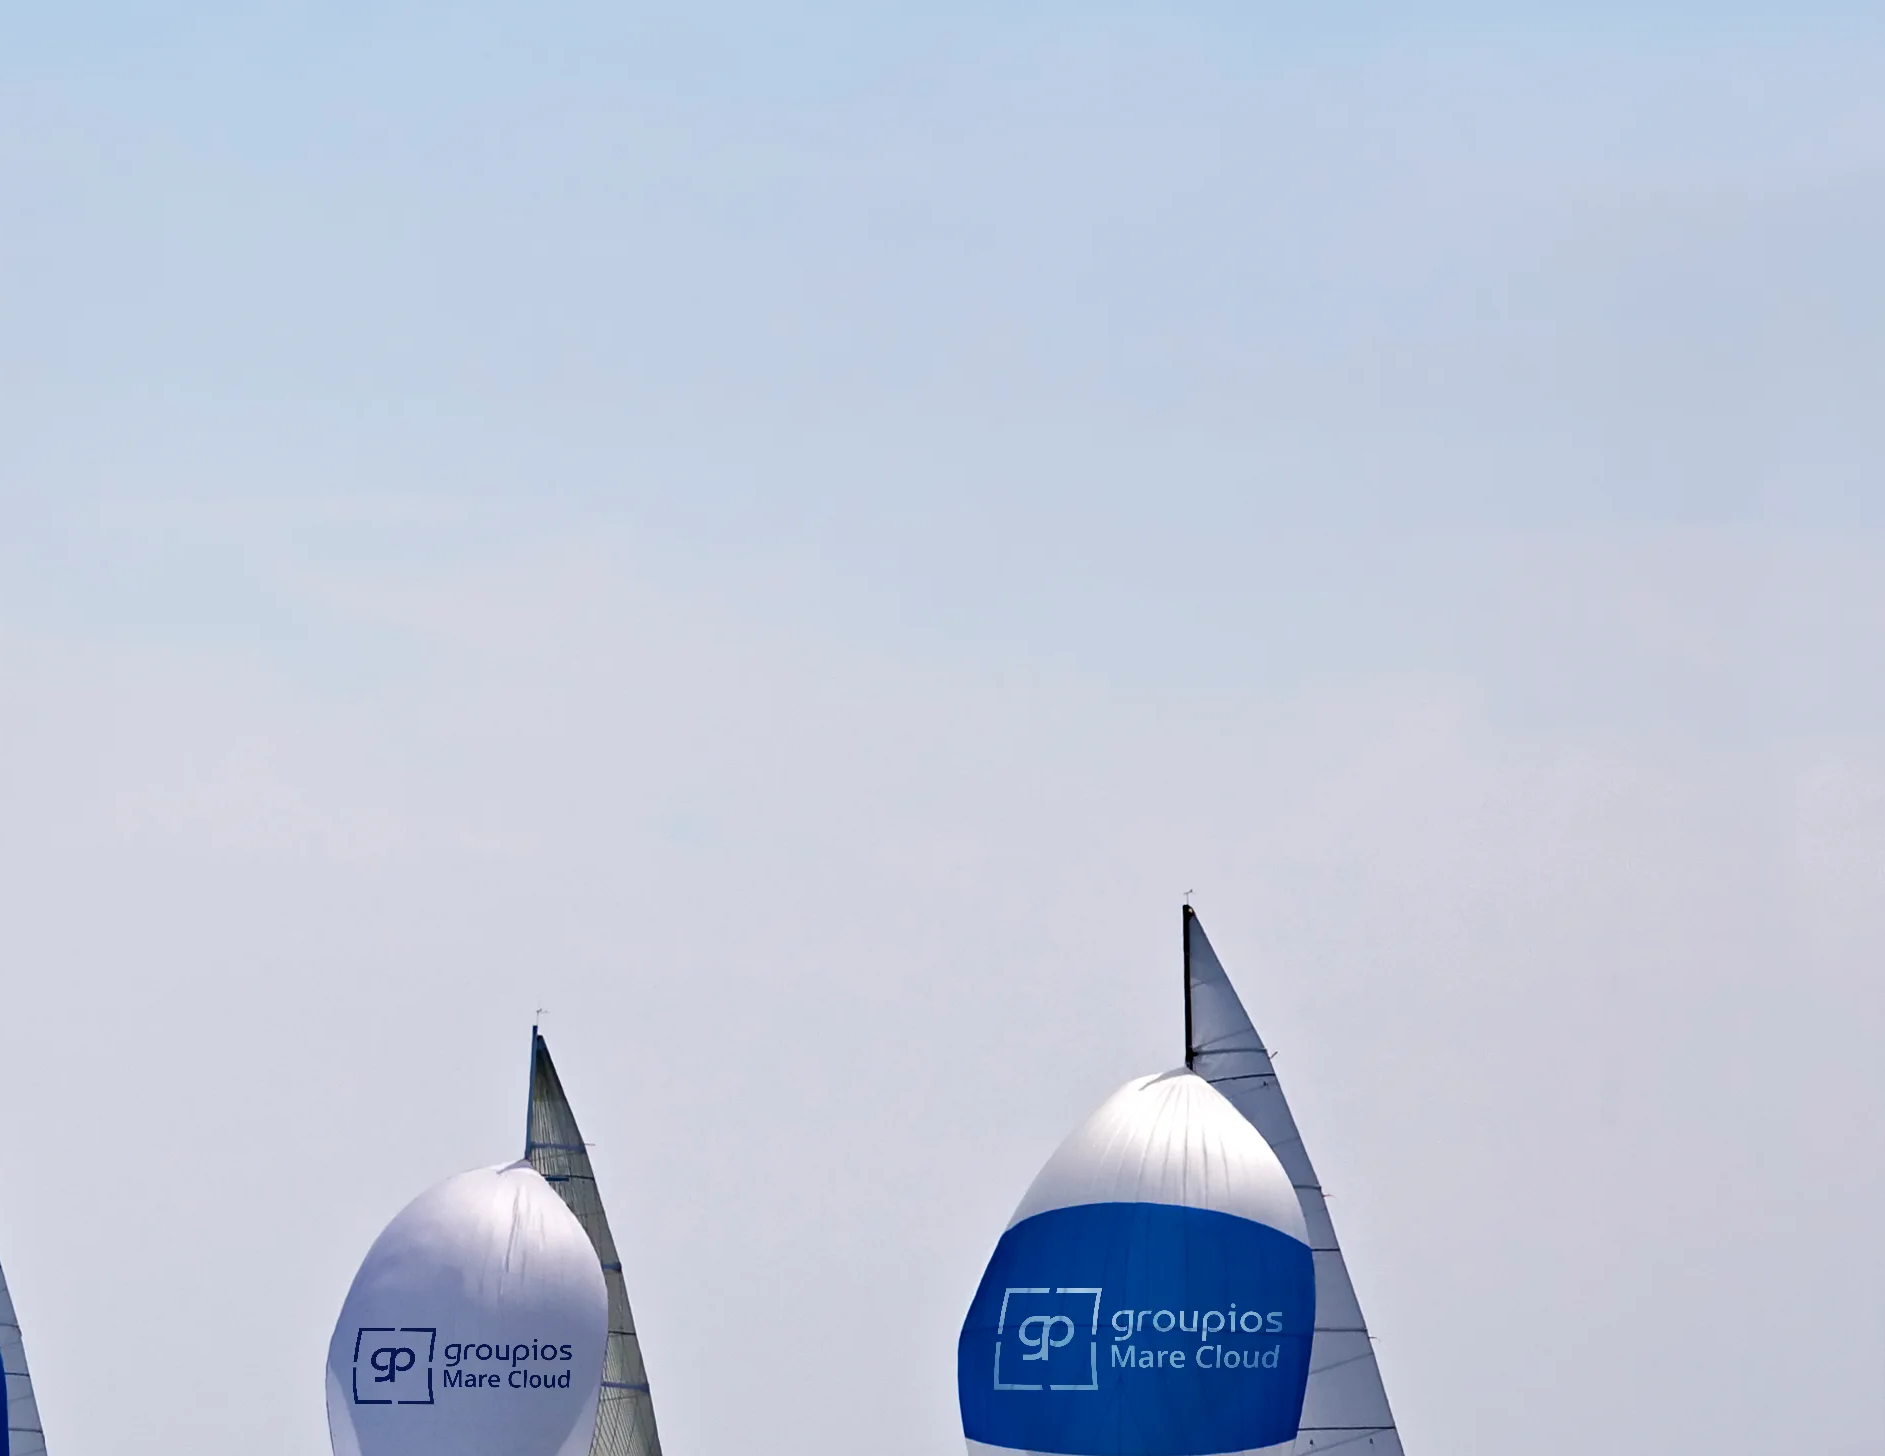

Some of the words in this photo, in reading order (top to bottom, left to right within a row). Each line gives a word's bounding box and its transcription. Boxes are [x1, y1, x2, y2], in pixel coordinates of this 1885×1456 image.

[1111, 1302, 1283, 1342] groupios
[444, 1338, 573, 1368] groupios
[1110, 1344, 1186, 1369] Mare
[1195, 1344, 1281, 1369] Cloud
[443, 1369, 501, 1388] Mare
[507, 1369, 571, 1389] Cloud
